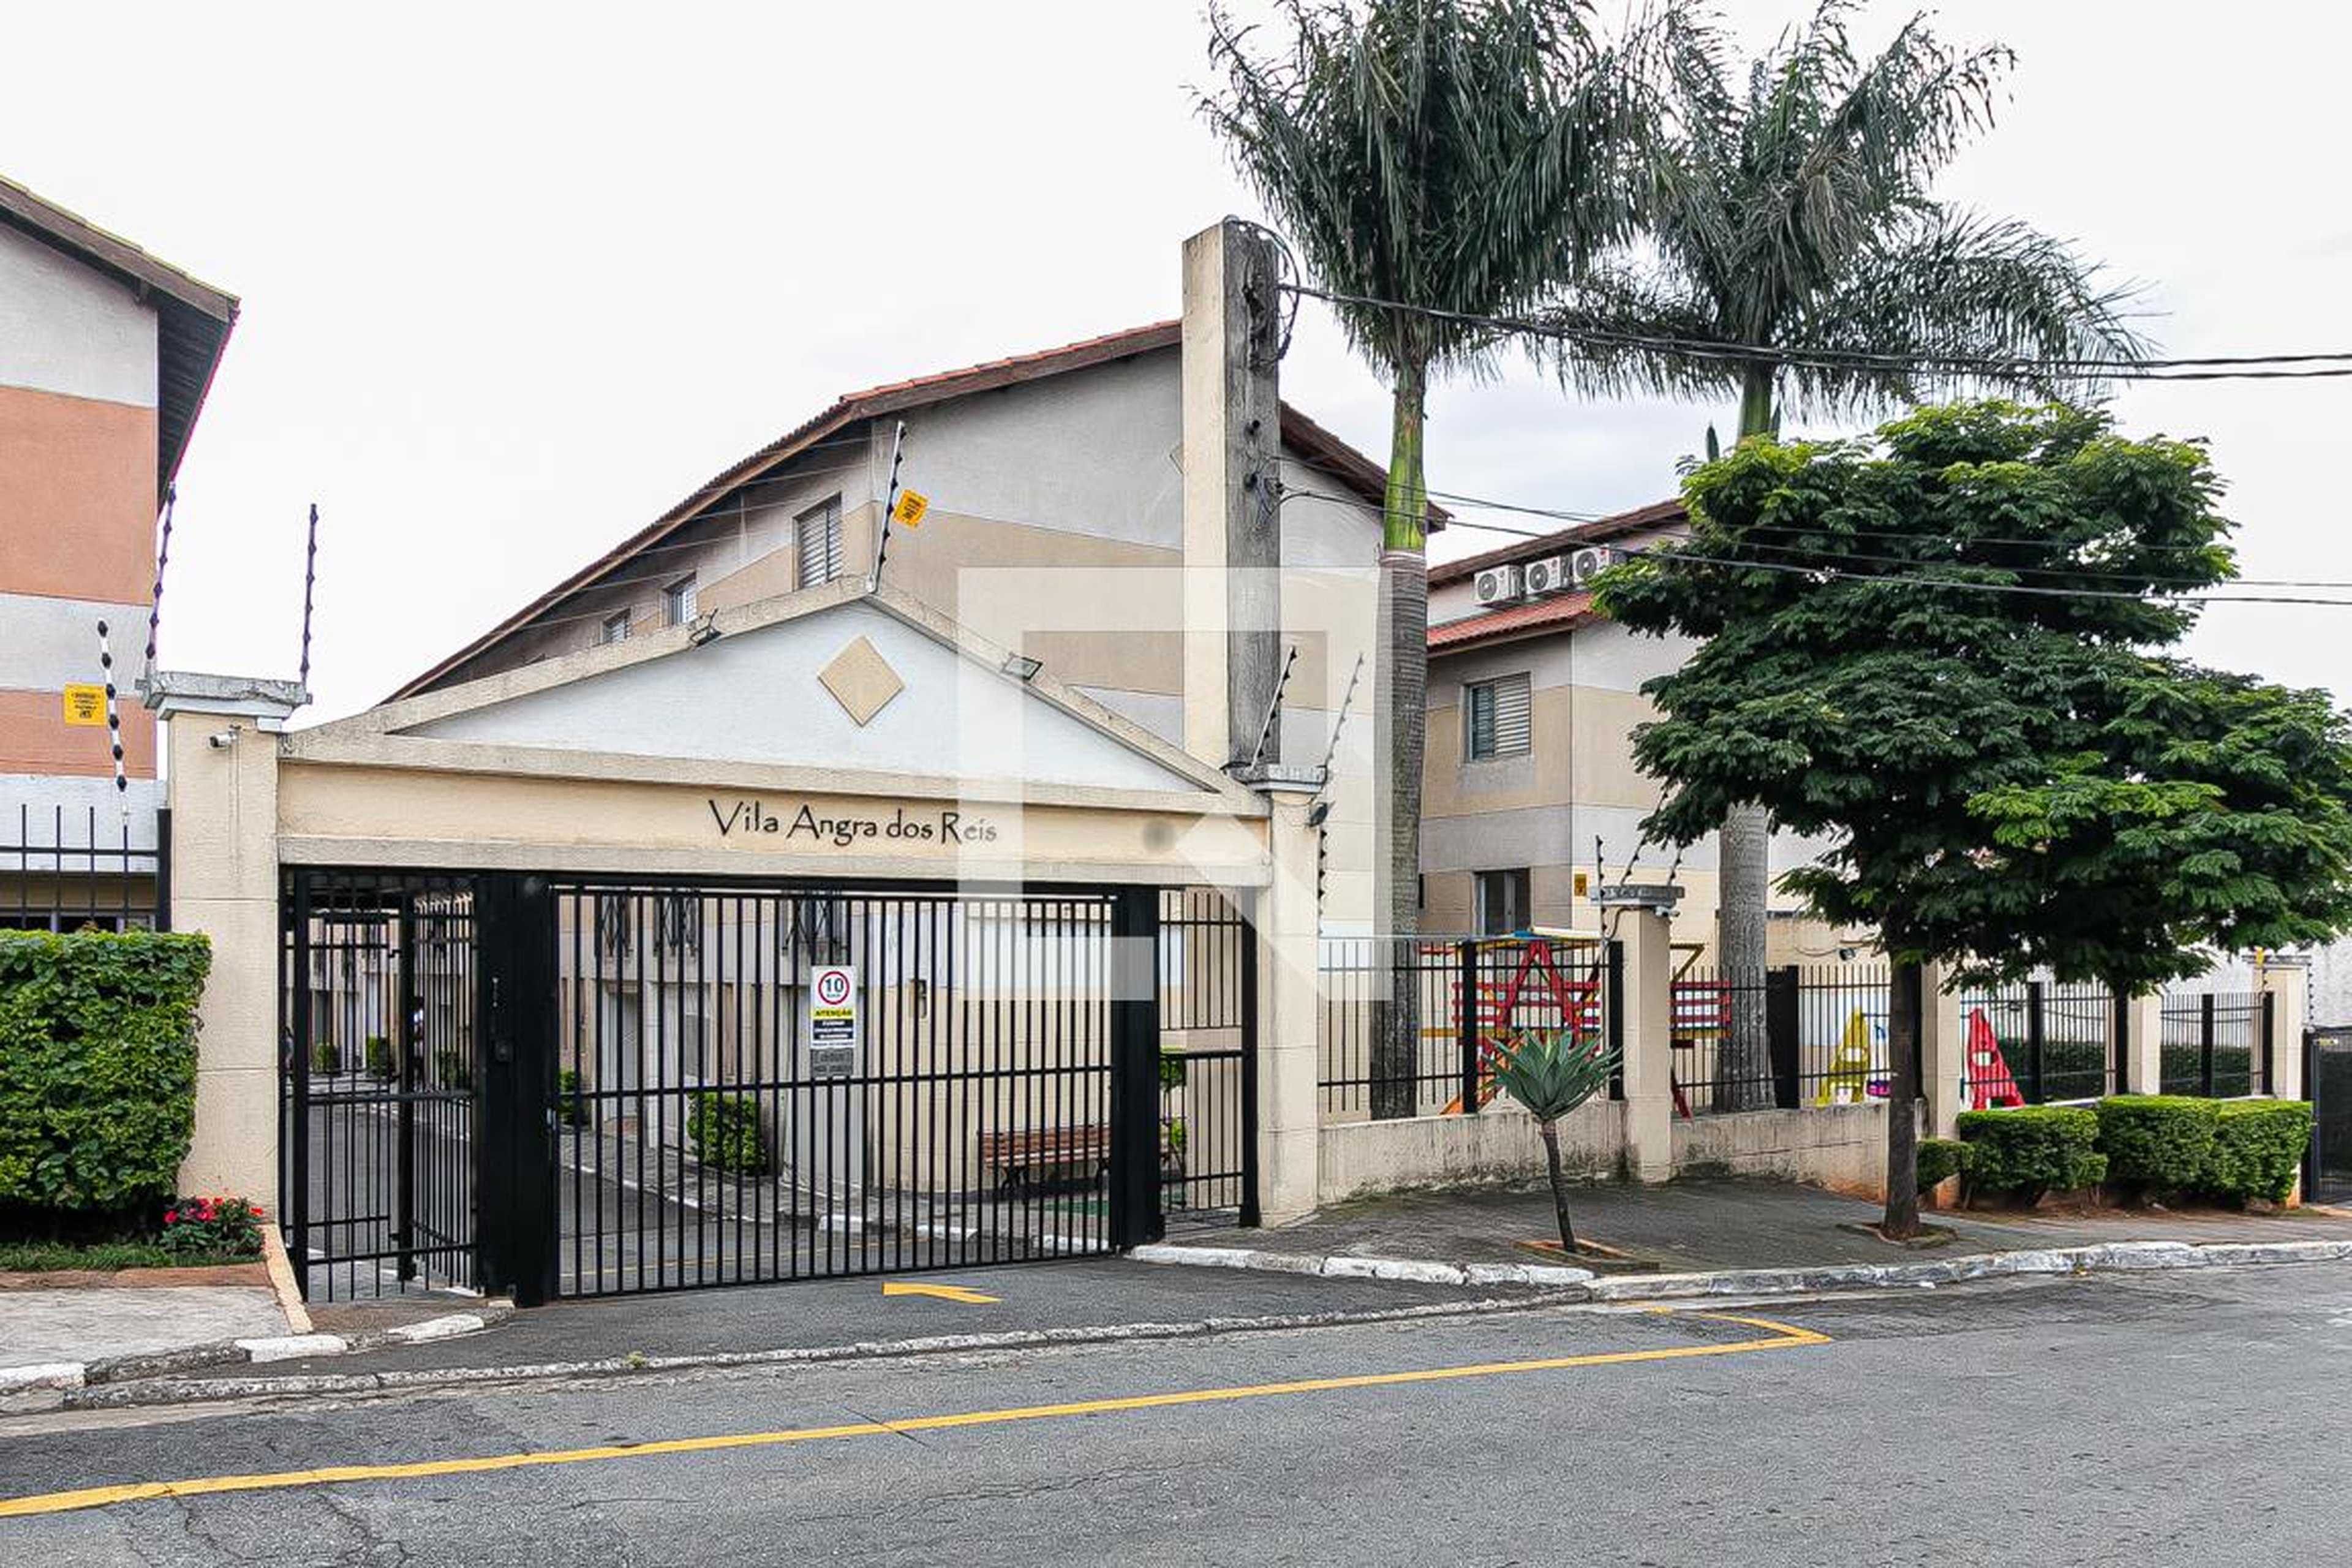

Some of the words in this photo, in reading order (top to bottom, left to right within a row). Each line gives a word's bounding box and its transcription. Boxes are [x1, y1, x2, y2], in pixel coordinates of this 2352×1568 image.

[708, 799, 778, 837] Vila
[786, 804, 878, 846] Angra
[886, 809, 933, 840] dos
[940, 812, 997, 845] Reis
[825, 978, 844, 992] 10
